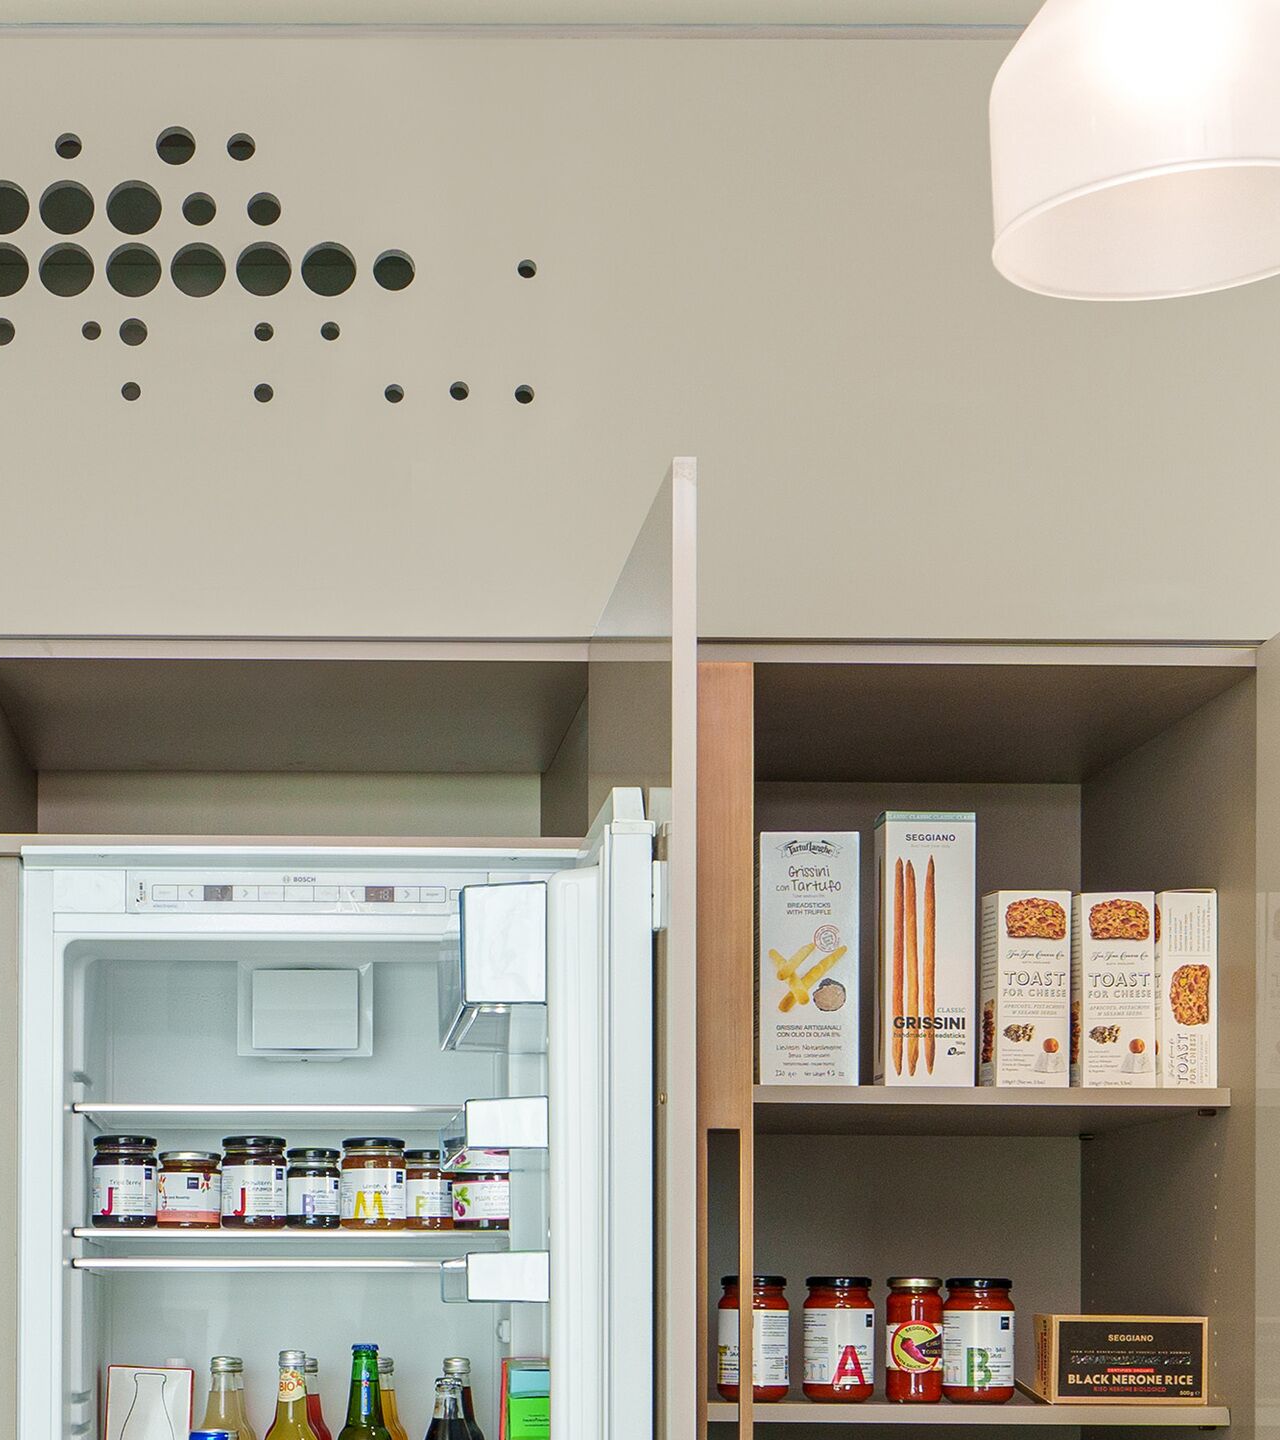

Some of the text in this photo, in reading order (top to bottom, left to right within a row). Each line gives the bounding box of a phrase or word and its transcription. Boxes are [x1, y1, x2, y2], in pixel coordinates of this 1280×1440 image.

[905, 833, 956, 842] SEGGIANO
[788, 865, 830, 878] Grissini
[776, 879, 842, 893] con Tartufo
[1004, 971, 1066, 986] TOAST
[1088, 972, 1151, 988] TOAST
[1003, 988, 1067, 998] FOR CHEESE
[1088, 990, 1152, 999] FOR CHEESE
[893, 1016, 966, 1030] GRISSINI
[1189, 1033, 1197, 1065] CHEESE
[1177, 1034, 1189, 1086] TOAST
[1108, 1334, 1154, 1342] SEGGIANO
[832, 1345, 865, 1385] A
[967, 1348, 992, 1386] B
[279, 1381, 295, 1392] BIO
[1068, 1374, 1193, 1386] BLACK NERONE RICE
